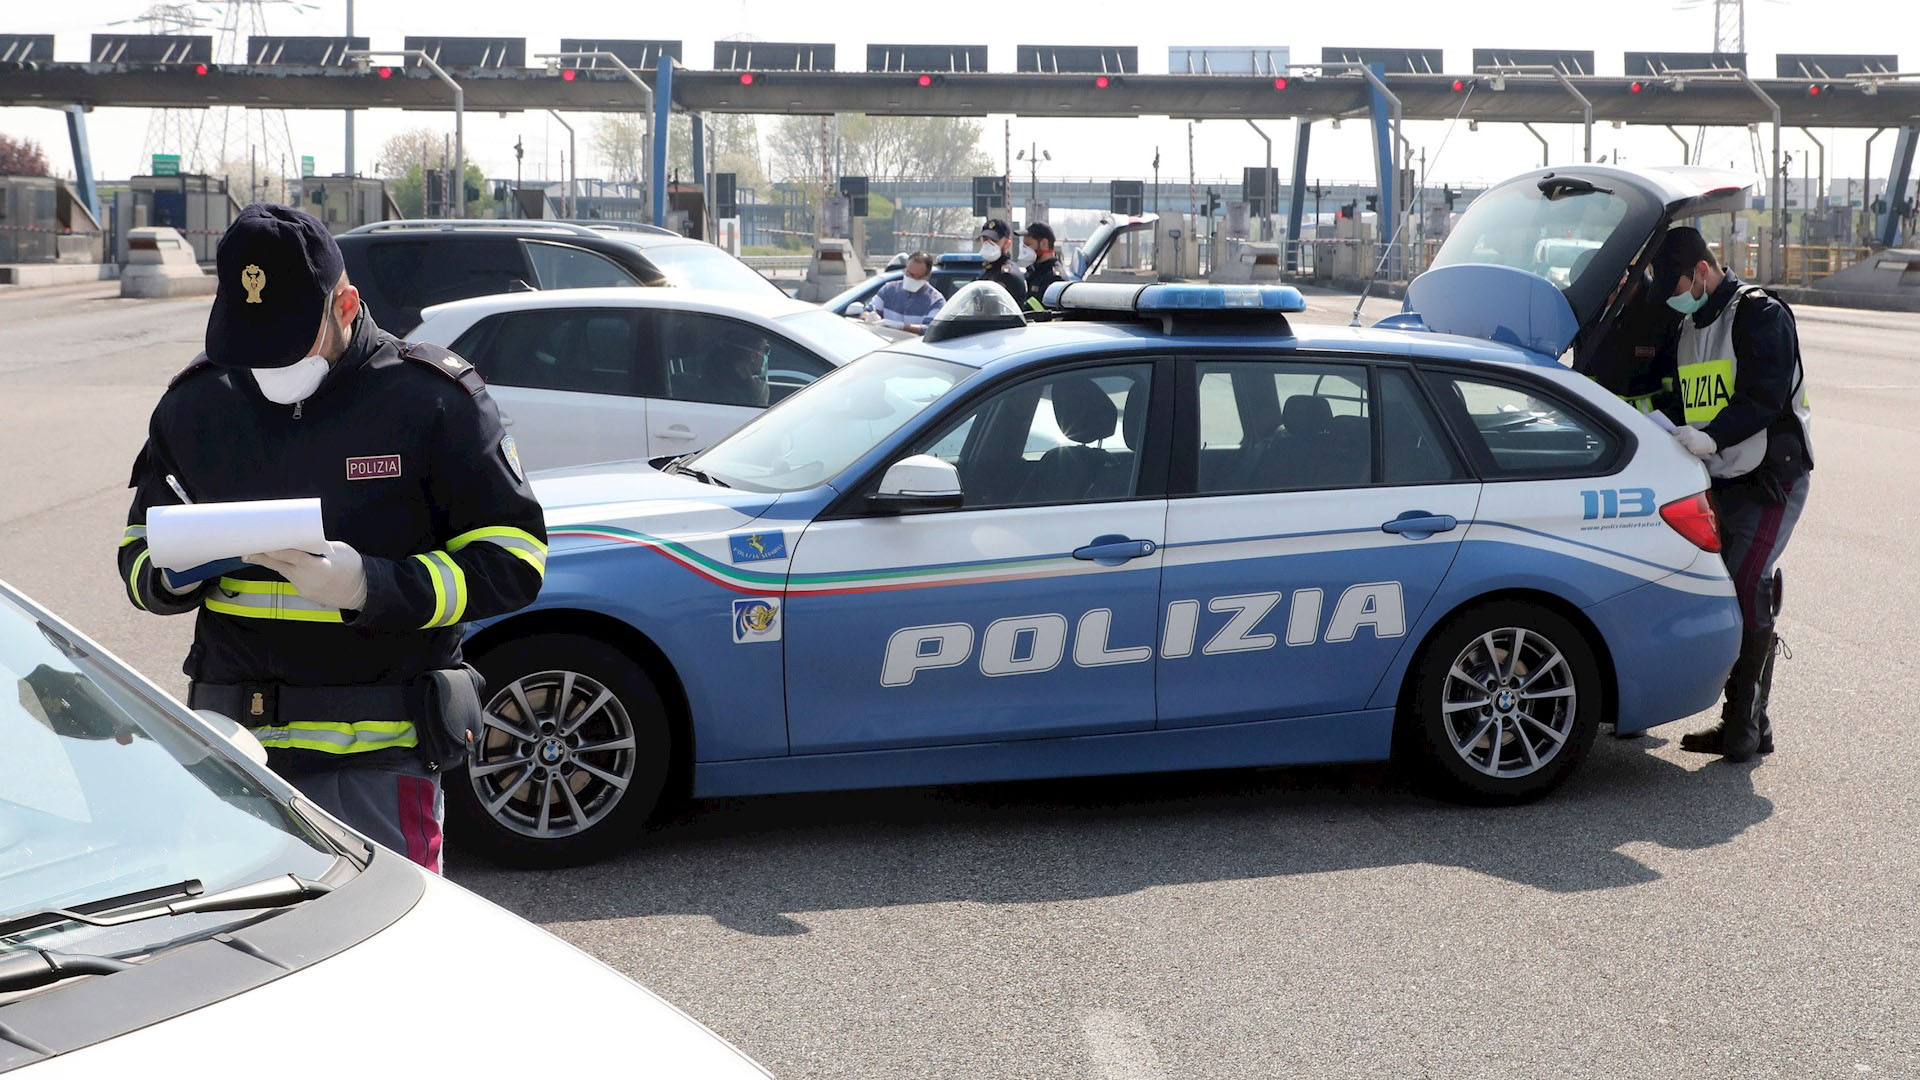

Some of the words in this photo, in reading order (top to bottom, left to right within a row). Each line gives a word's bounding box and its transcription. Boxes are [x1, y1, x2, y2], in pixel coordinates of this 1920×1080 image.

[1681, 373, 1730, 409] OLIZIA
[350, 460, 397, 475] POLIZIA
[1580, 487, 1656, 520] 113
[880, 580, 1407, 688] POLIZIA
